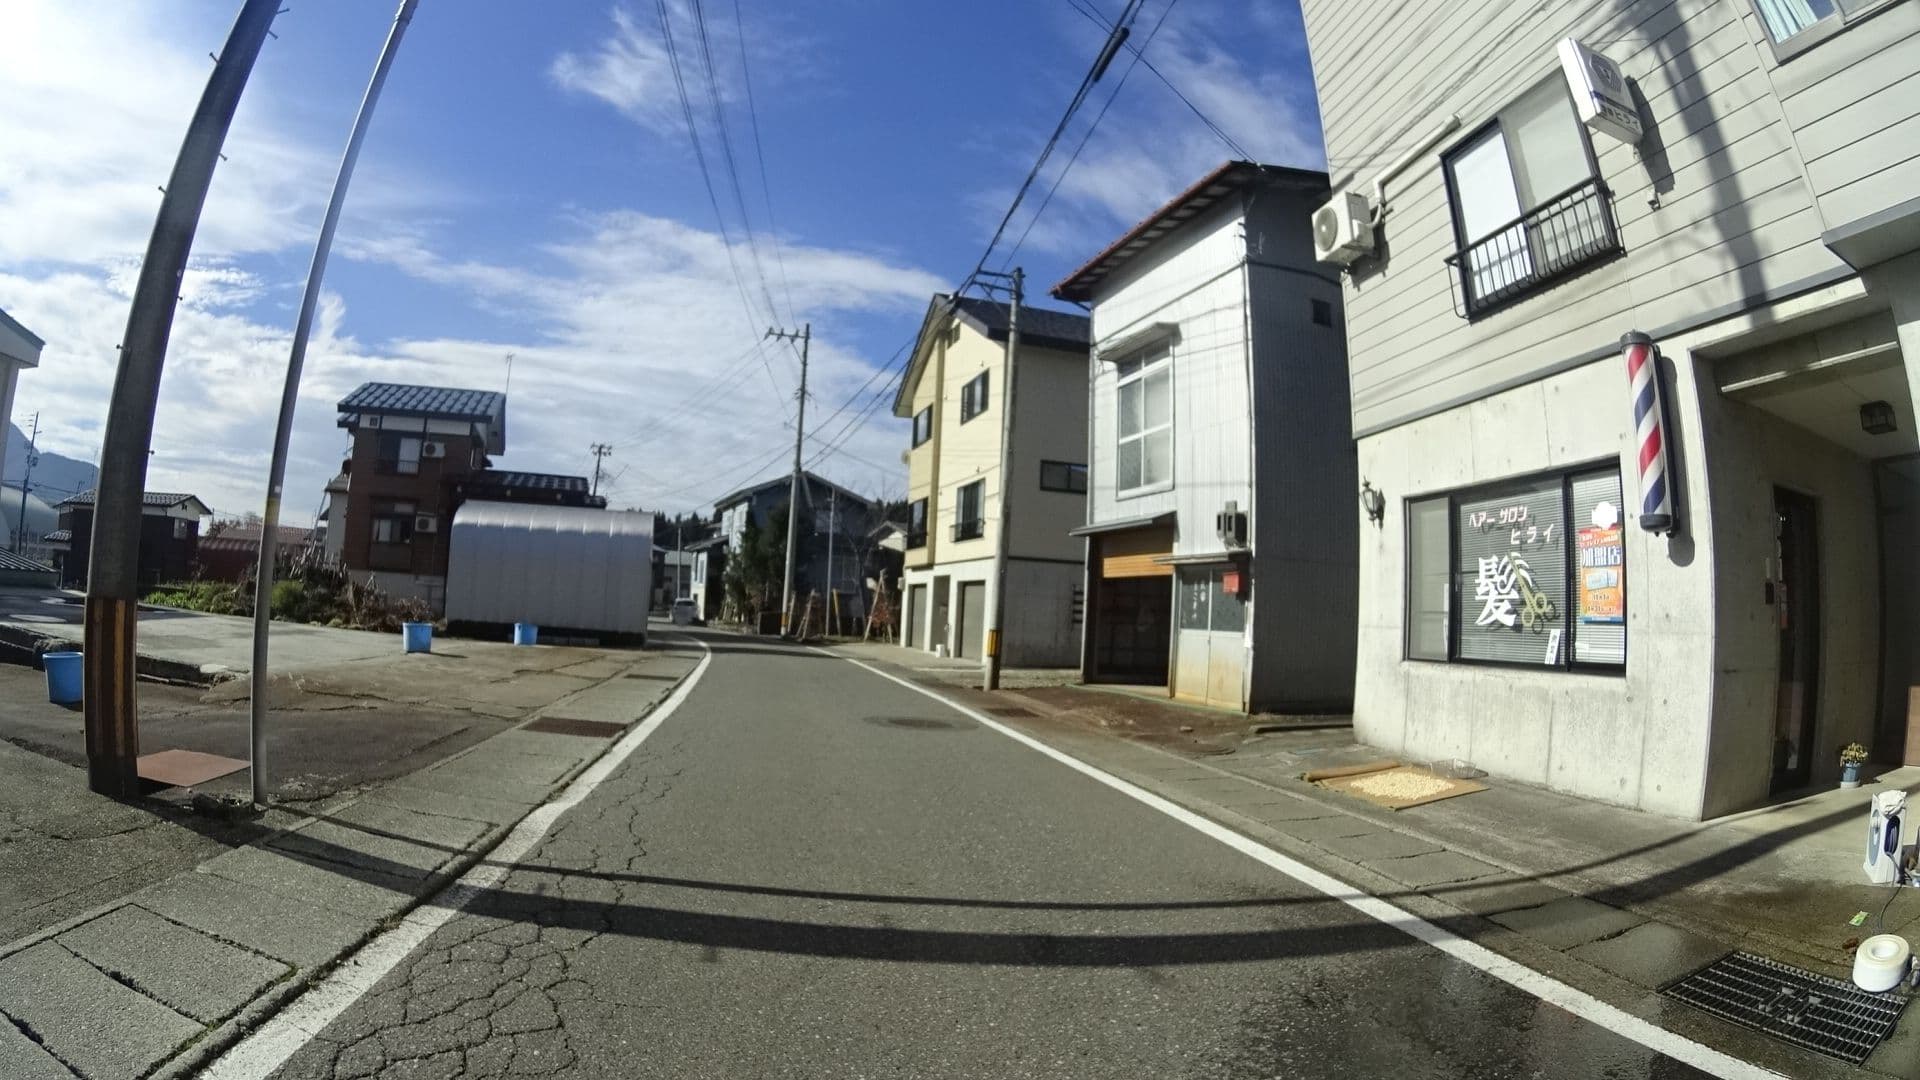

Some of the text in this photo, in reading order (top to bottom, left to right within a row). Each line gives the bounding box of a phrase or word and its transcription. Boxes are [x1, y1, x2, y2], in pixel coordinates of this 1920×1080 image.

[1511, 523, 1554, 544] ヒライ
[1475, 552, 1533, 626] 髪
